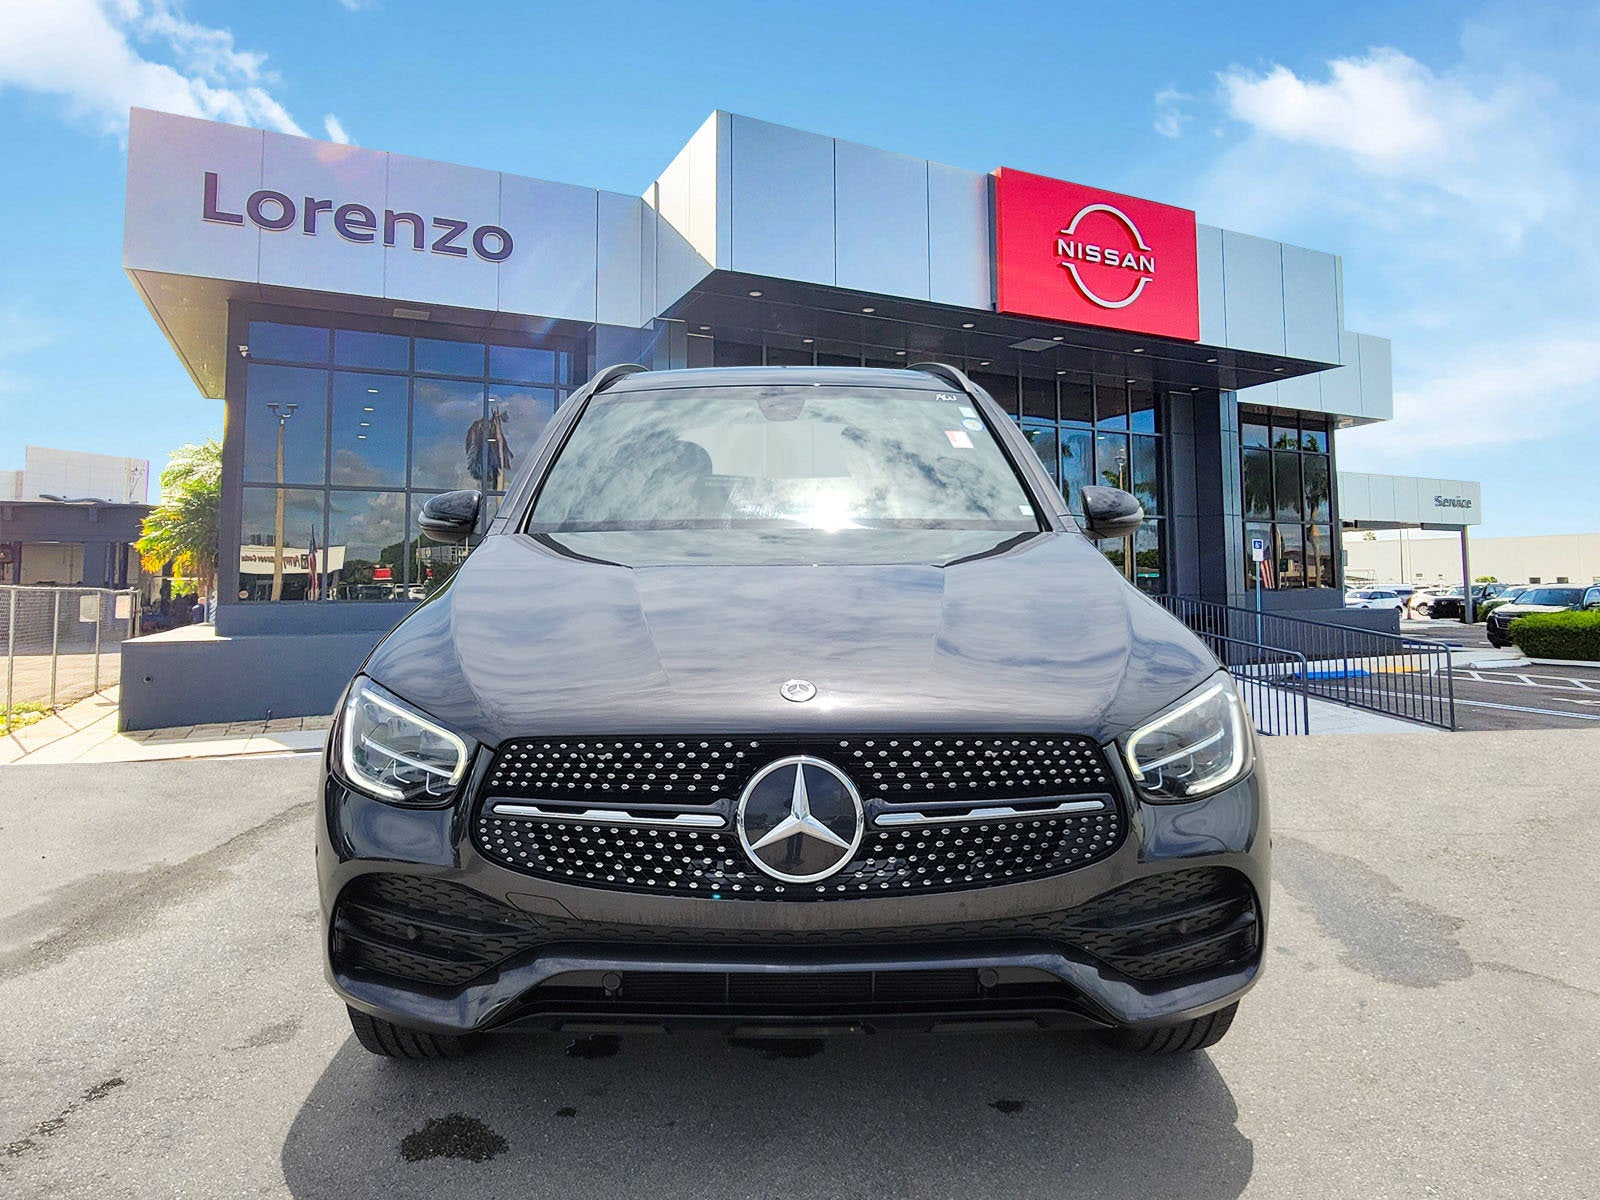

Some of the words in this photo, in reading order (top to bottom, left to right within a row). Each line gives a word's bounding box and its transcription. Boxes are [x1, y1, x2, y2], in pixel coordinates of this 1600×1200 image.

[202, 170, 515, 263] Lorenzo
[1057, 238, 1155, 273] NISSAN
[1434, 495, 1472, 508] Service
